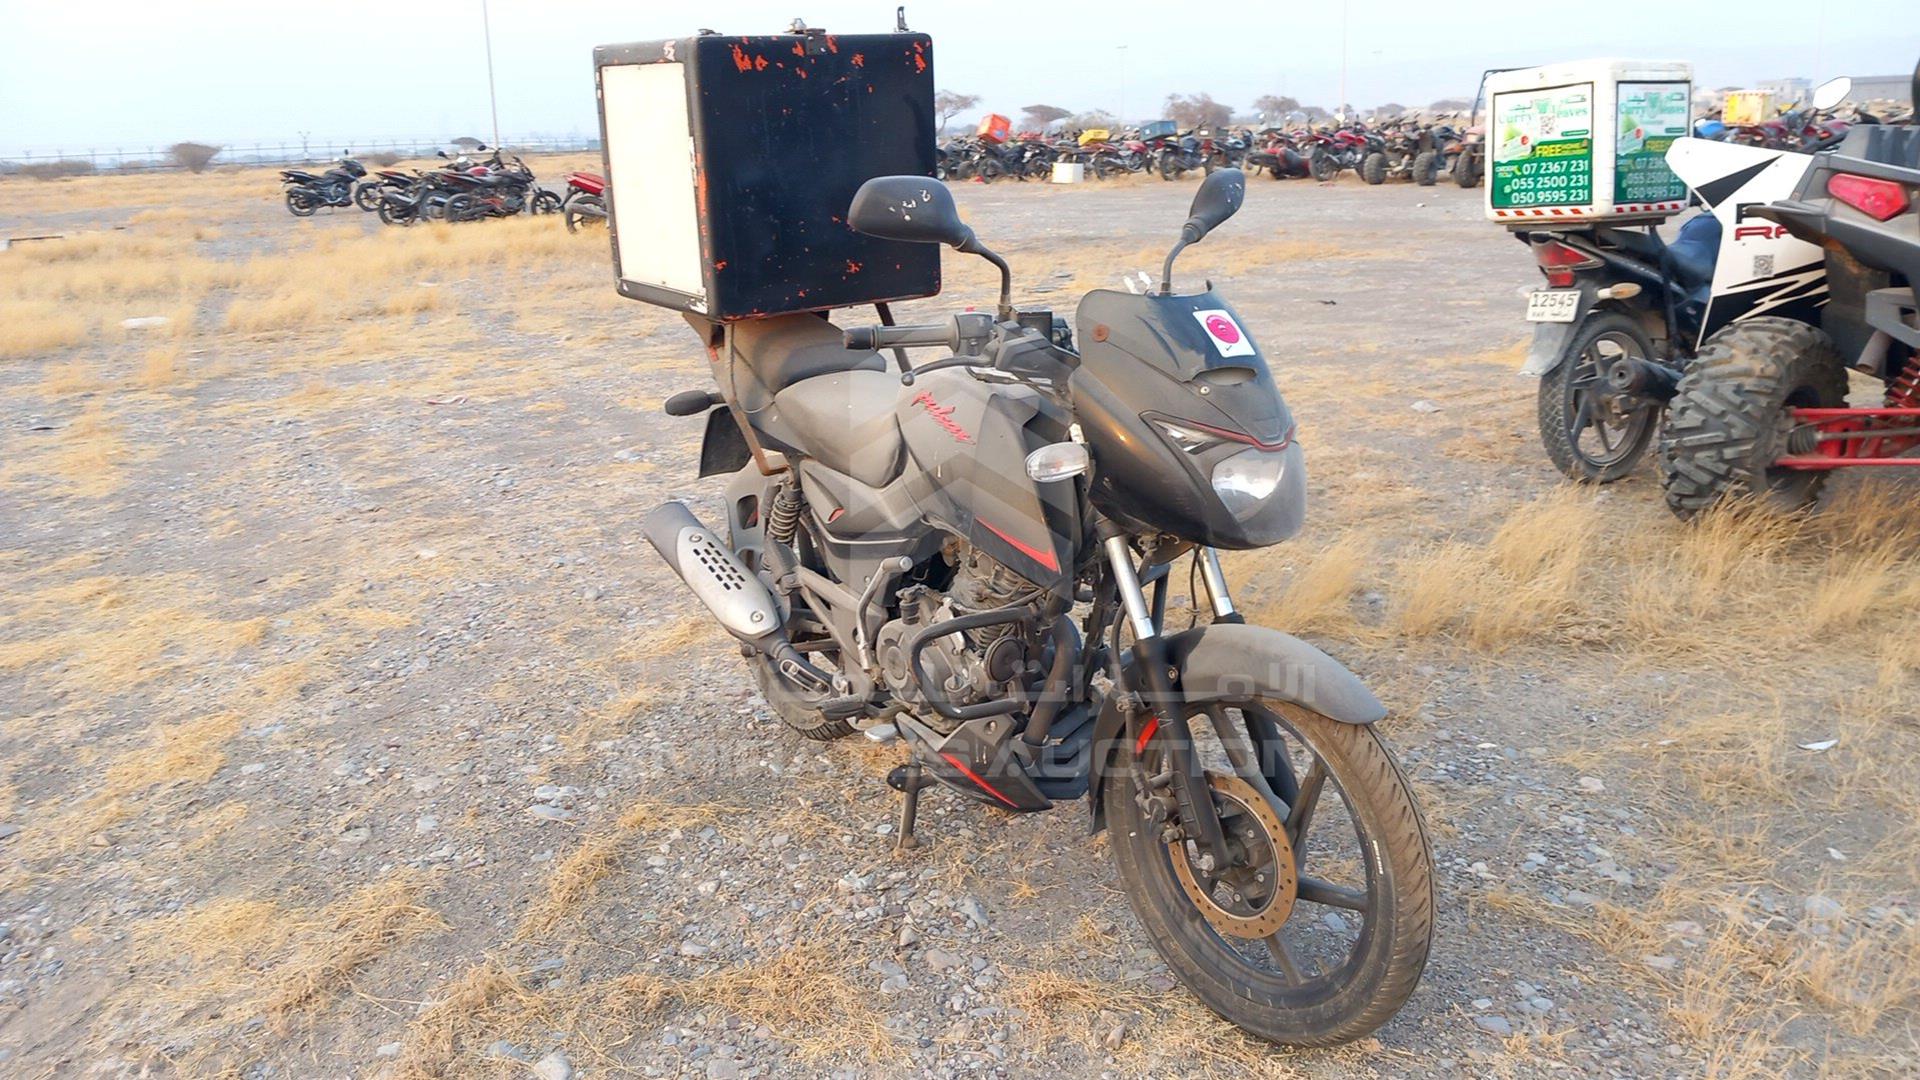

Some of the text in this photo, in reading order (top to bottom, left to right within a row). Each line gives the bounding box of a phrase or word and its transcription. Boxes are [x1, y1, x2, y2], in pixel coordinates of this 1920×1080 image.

[1536, 145, 1562, 158] FREE
[1522, 159, 1588, 175] 07 2367 231
[1511, 174, 1588, 190] 055 2500 231
[1511, 189, 1588, 204] 050 9595 231
[1531, 293, 1577, 308] 12545
